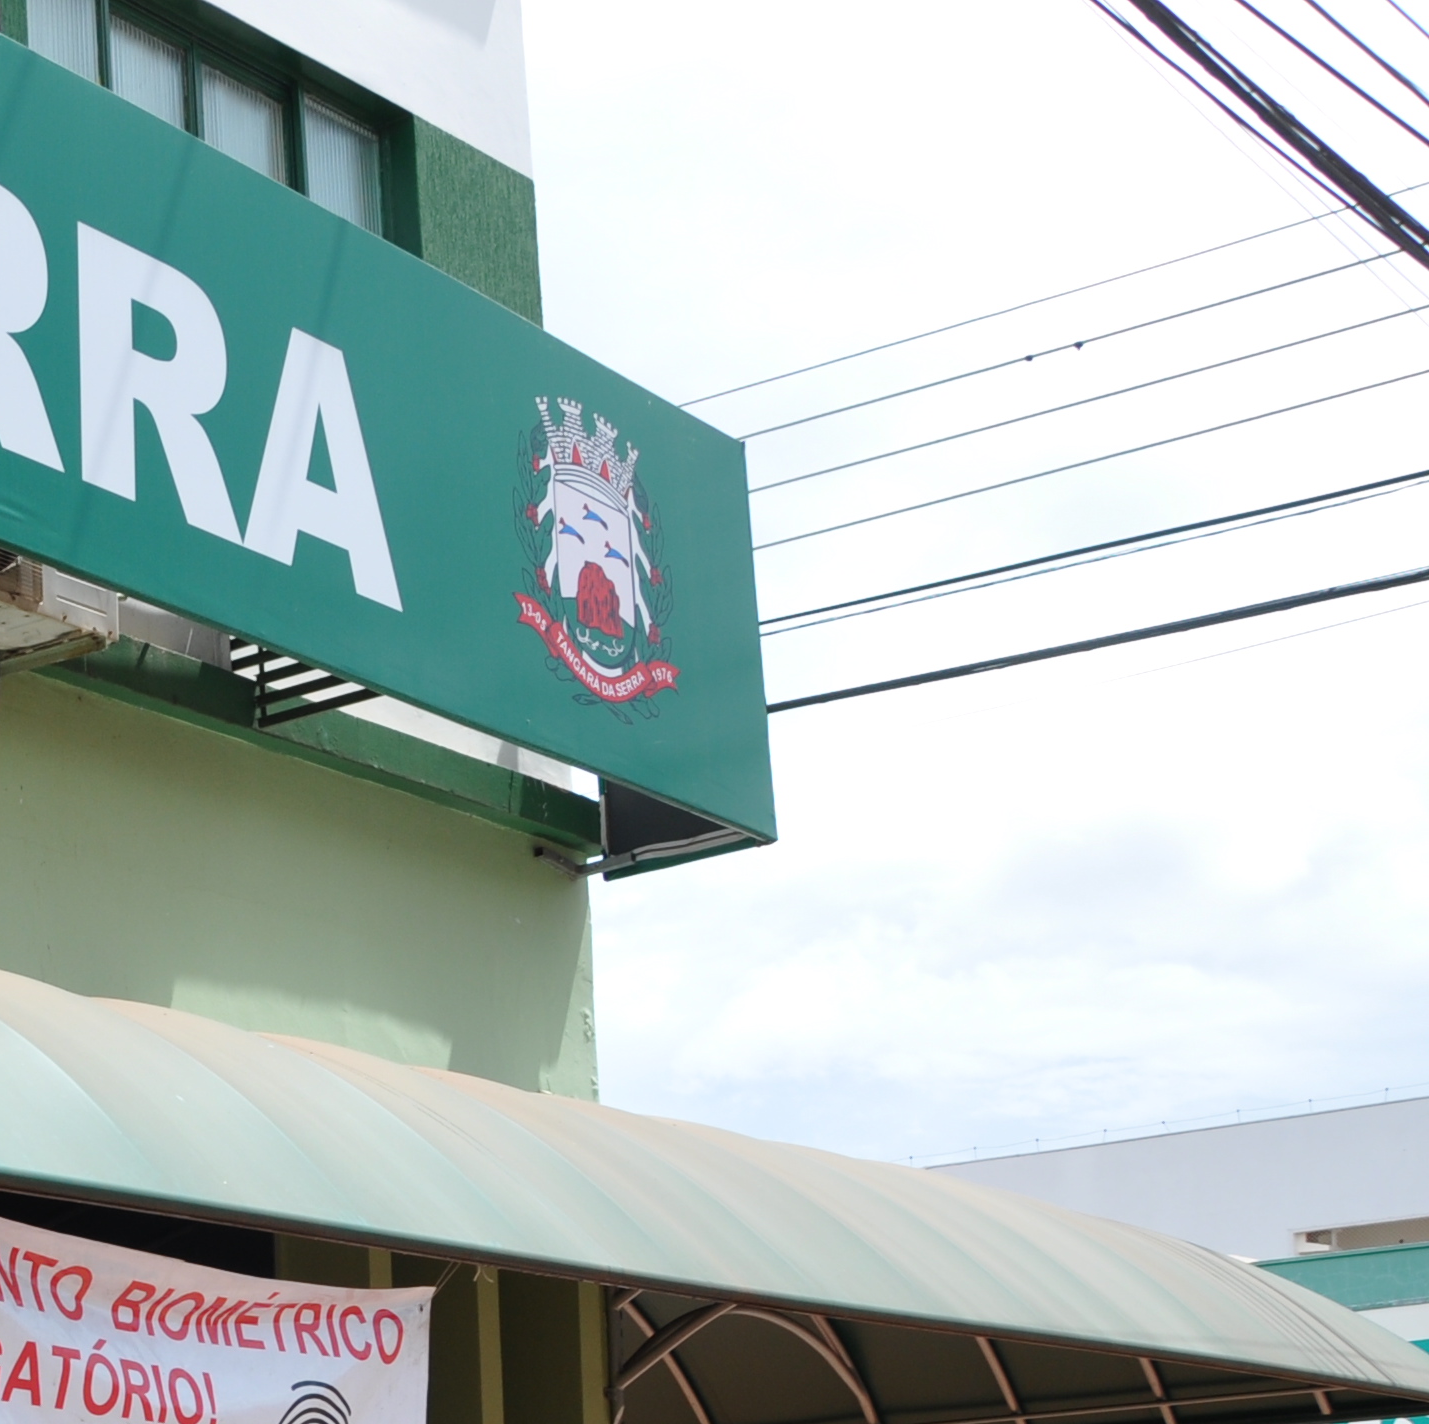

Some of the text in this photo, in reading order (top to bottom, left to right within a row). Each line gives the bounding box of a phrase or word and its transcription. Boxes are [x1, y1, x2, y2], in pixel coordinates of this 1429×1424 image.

[601, 681, 617, 698] DA
[616, 670, 646, 697] SERRA
[652, 668, 674, 684] 1976
[110, 1279, 405, 1366] BIOMÉTRICO
